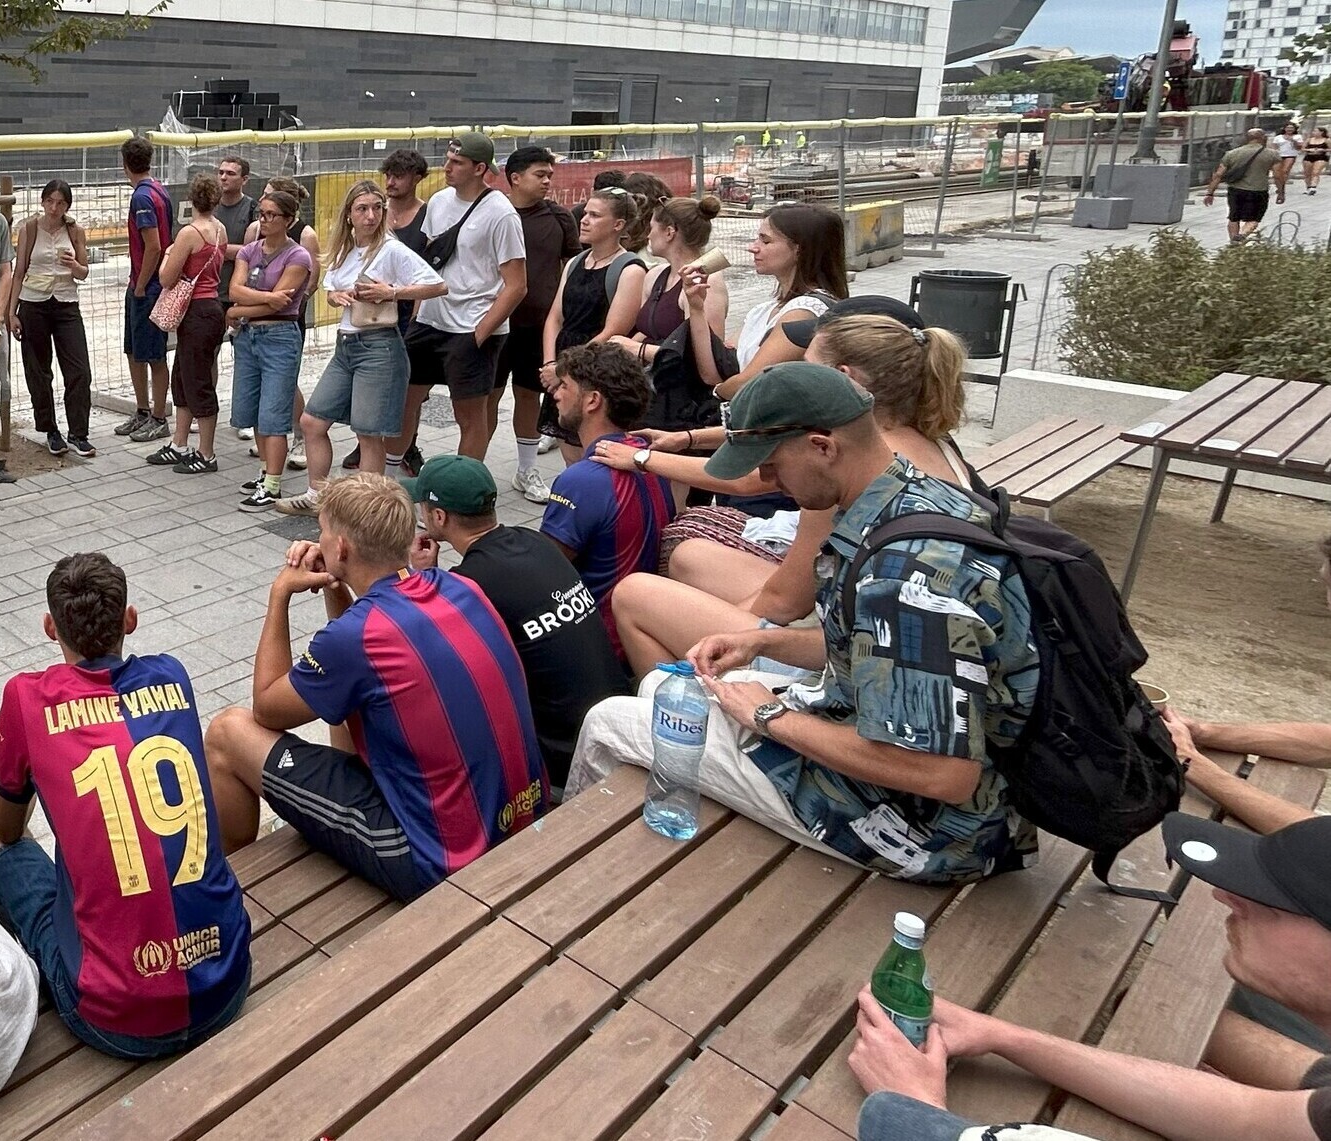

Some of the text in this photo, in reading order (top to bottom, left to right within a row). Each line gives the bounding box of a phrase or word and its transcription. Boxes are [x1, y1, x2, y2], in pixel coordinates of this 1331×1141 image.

[44, 682, 190, 735] LAMINE YAMAL
[660, 711, 704, 735] Ribes
[71, 734, 209, 897] 19
[172, 925, 220, 952] UNHCR
[176, 938, 221, 966] ACNUR
